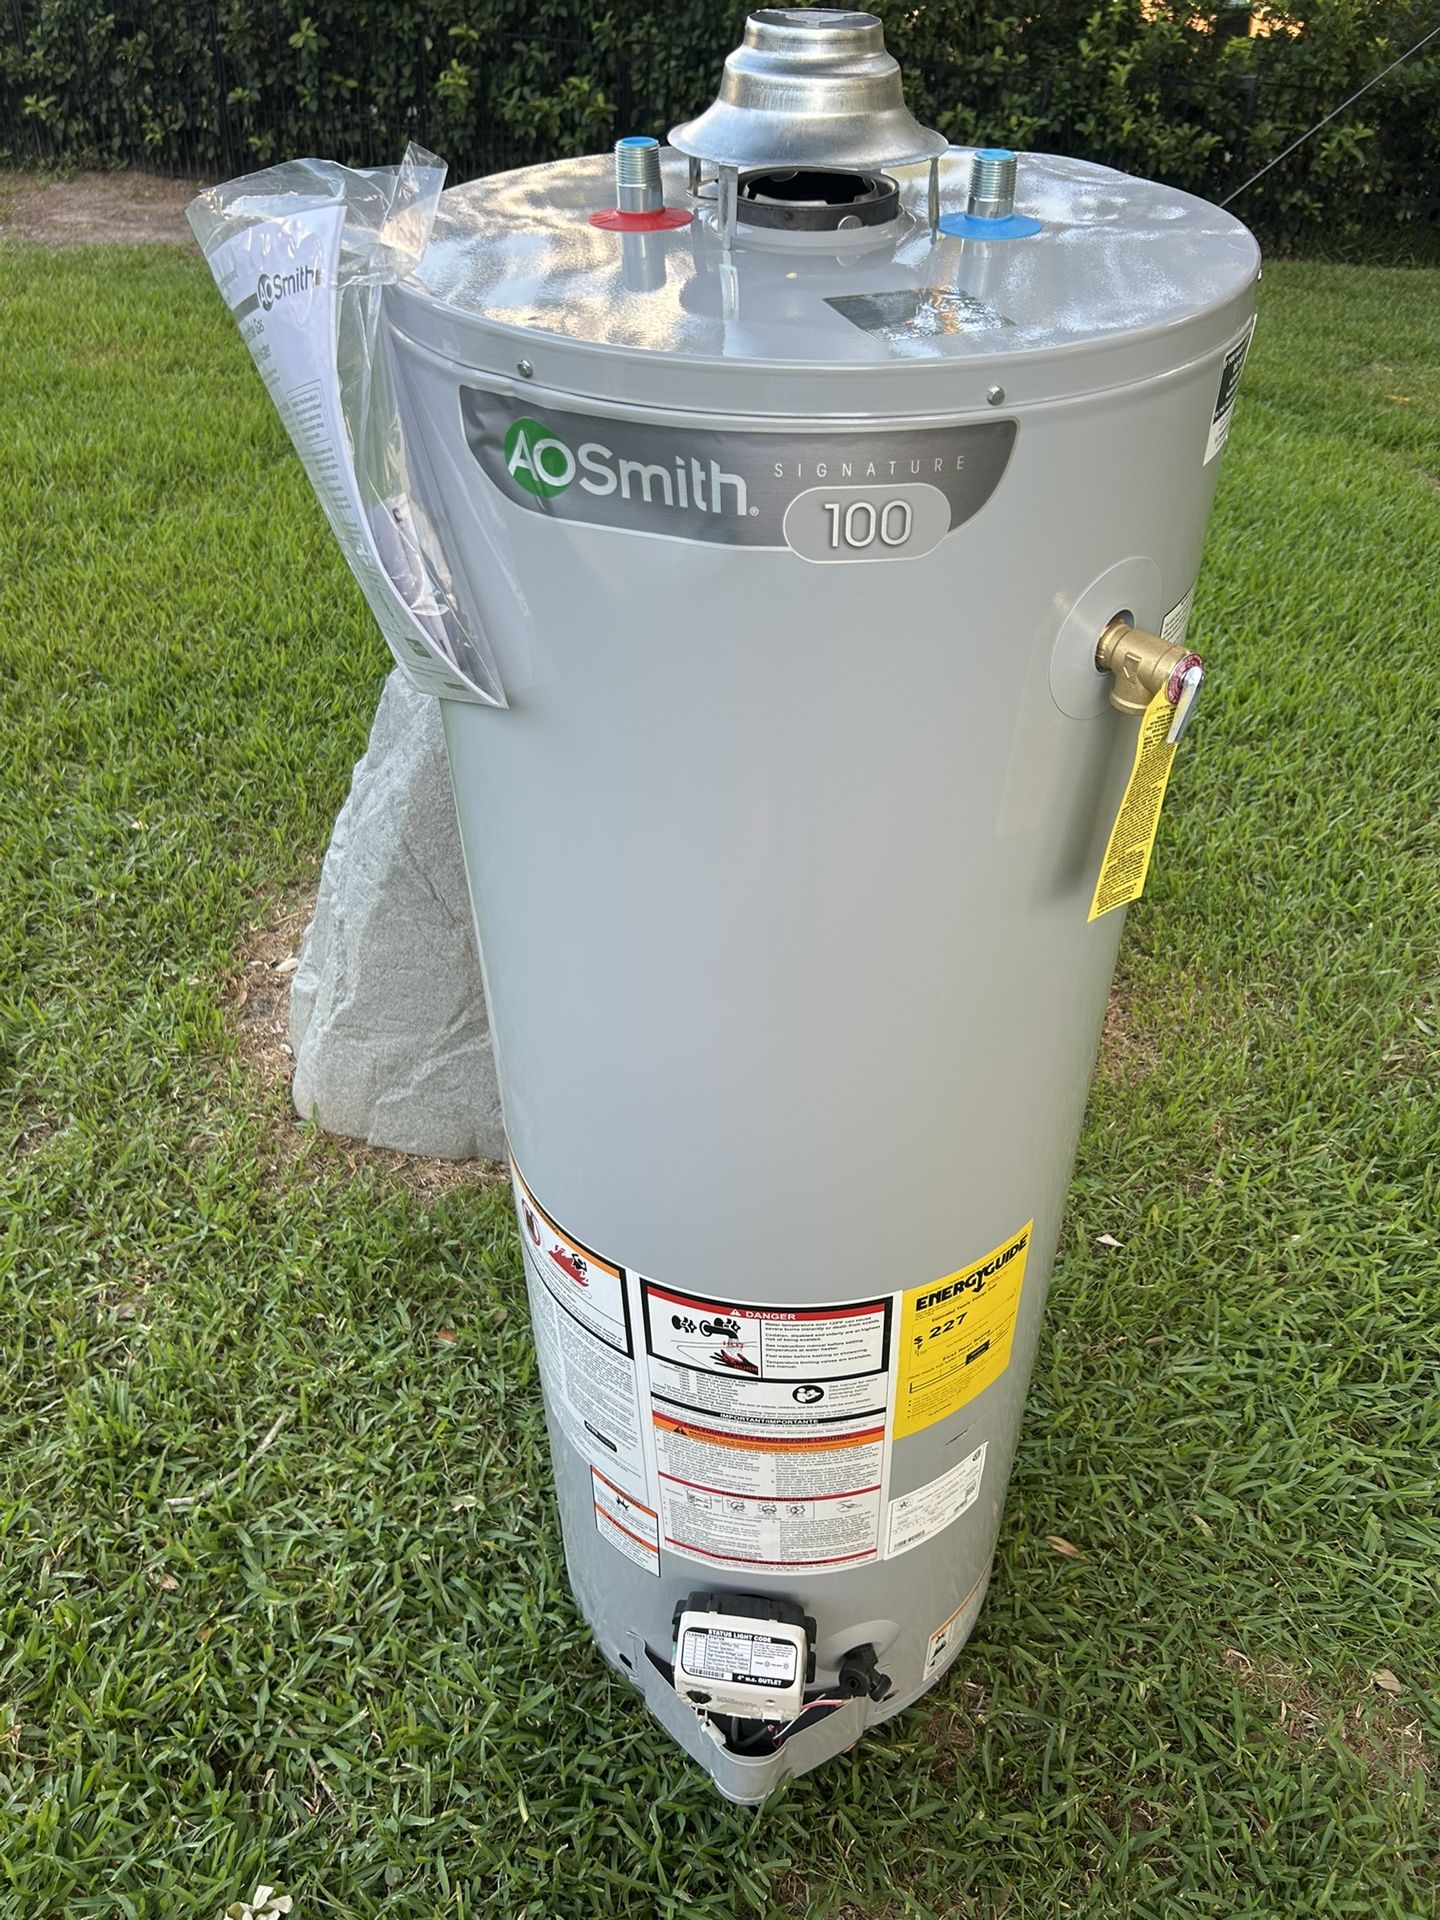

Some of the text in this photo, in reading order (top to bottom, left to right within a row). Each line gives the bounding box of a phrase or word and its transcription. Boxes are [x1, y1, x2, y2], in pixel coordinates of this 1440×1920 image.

[773, 455, 965, 478] SIGNATURE
[823, 499, 912, 549] 100
[915, 1233, 1028, 1312] ENERGYGUIDE
[745, 1310, 797, 1320] DANGER
[928, 1311, 968, 1340] 227
[720, 1412, 819, 1425] IMPORTANT/IMPORTANTE
[708, 1628, 772, 1643] STATUS LIGHT CODE
[757, 1677, 782, 1686] OUTLET
